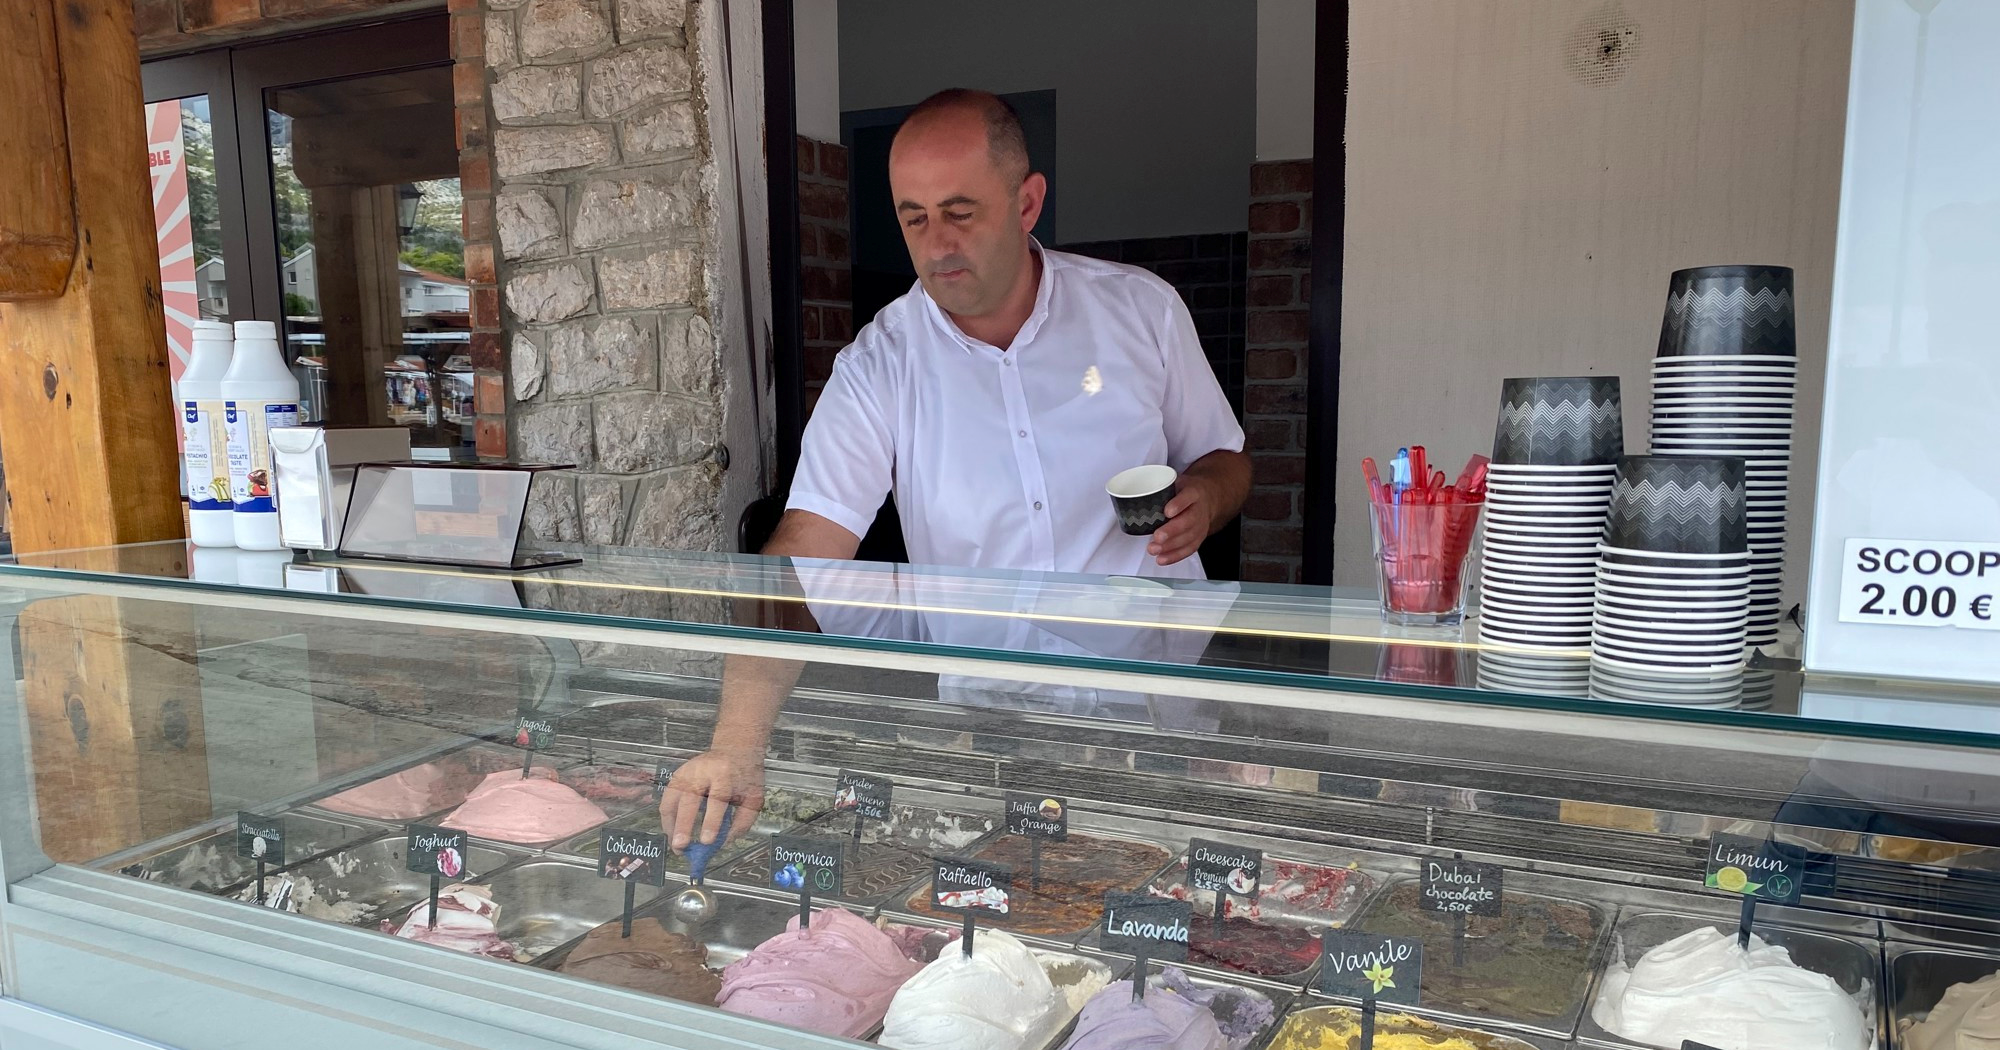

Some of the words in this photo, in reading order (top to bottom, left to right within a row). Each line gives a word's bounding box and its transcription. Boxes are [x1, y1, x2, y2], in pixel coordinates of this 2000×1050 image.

[149, 150, 171, 167] BLE
[1857, 547, 2000, 577] SCOOP
[1858, 583, 1957, 618] 2.00
[1969, 594, 1993, 620] €
[517, 717, 553, 733] Jagoda
[843, 774, 875, 790] Kinder
[856, 793, 885, 807] Bueno
[1010, 801, 1039, 815] Jaffa
[241, 822, 281, 841] Stracciatella
[1020, 817, 1061, 834] Orange
[411, 833, 461, 852] Joghurt
[606, 835, 662, 858] Čokolada
[774, 846, 837, 867] Borovnica
[1195, 848, 1257, 870] Cheescake
[1715, 844, 1789, 873] Limun
[938, 867, 992, 887] Raffaello
[1428, 862, 1482, 884] Dubai
[1425, 883, 1495, 902] chocolate
[1436, 900, 1474, 914] 2,50€
[1107, 909, 1189, 943] Lavanda
[1329, 939, 1413, 974] Vanile
